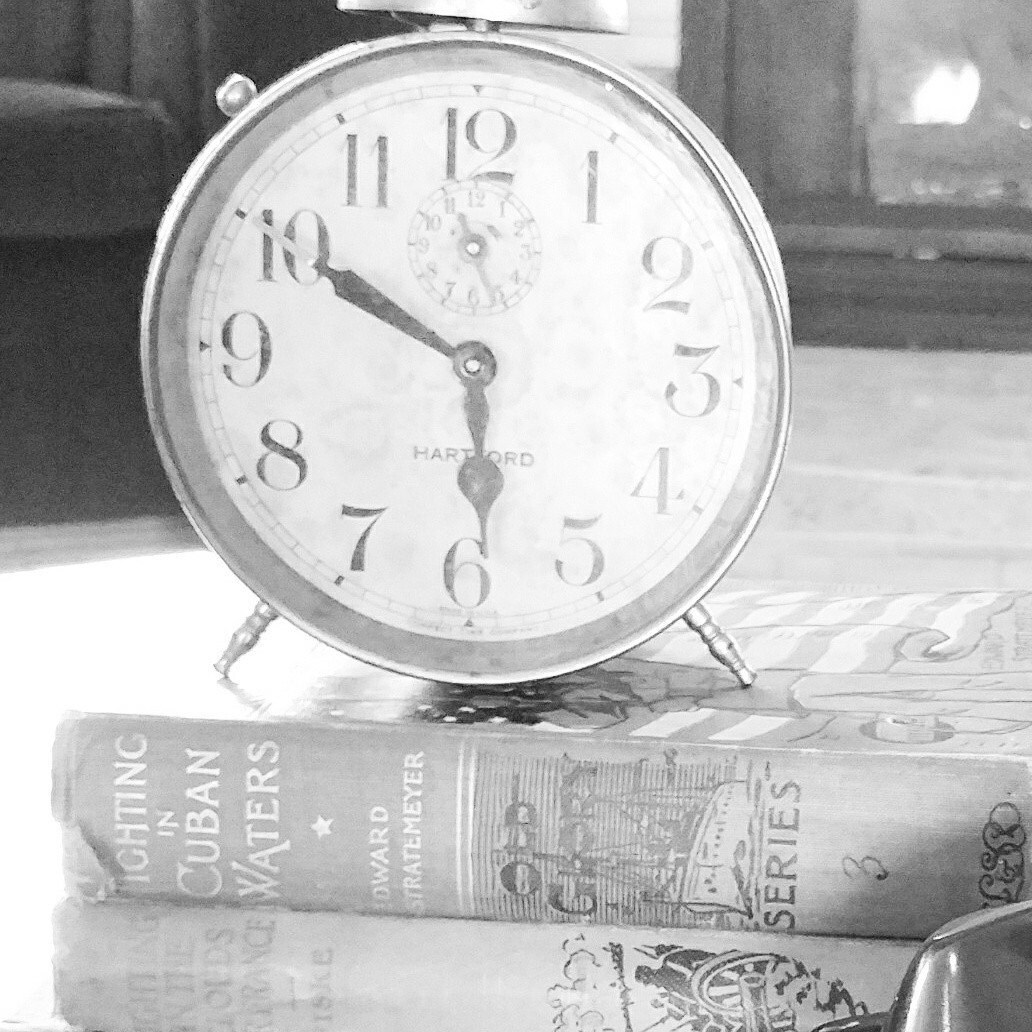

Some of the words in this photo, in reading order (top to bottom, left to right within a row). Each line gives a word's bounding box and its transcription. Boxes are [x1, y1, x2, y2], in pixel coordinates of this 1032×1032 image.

[341, 133, 389, 208] 11
[441, 106, 517, 186] 12
[584, 150, 603, 225] 1
[256, 208, 331, 285] 10
[641, 236, 694, 314] 2
[221, 310, 272, 387] 9
[665, 343, 722, 418] 3
[255, 419, 308, 491] 8
[413, 445, 535, 467] HARTORD
[629, 446, 685, 516] 4
[340, 504, 388, 572] 7
[443, 536, 492, 609] 6
[554, 514, 605, 586] 5
[112, 733, 149, 884] IGHTING
[156, 809, 180, 837] IN
[176, 747, 223, 897] CUBAN
[231, 739, 291, 899] WATERS
[369, 805, 390, 905] DWARD
[763, 780, 801, 929] SERIES
